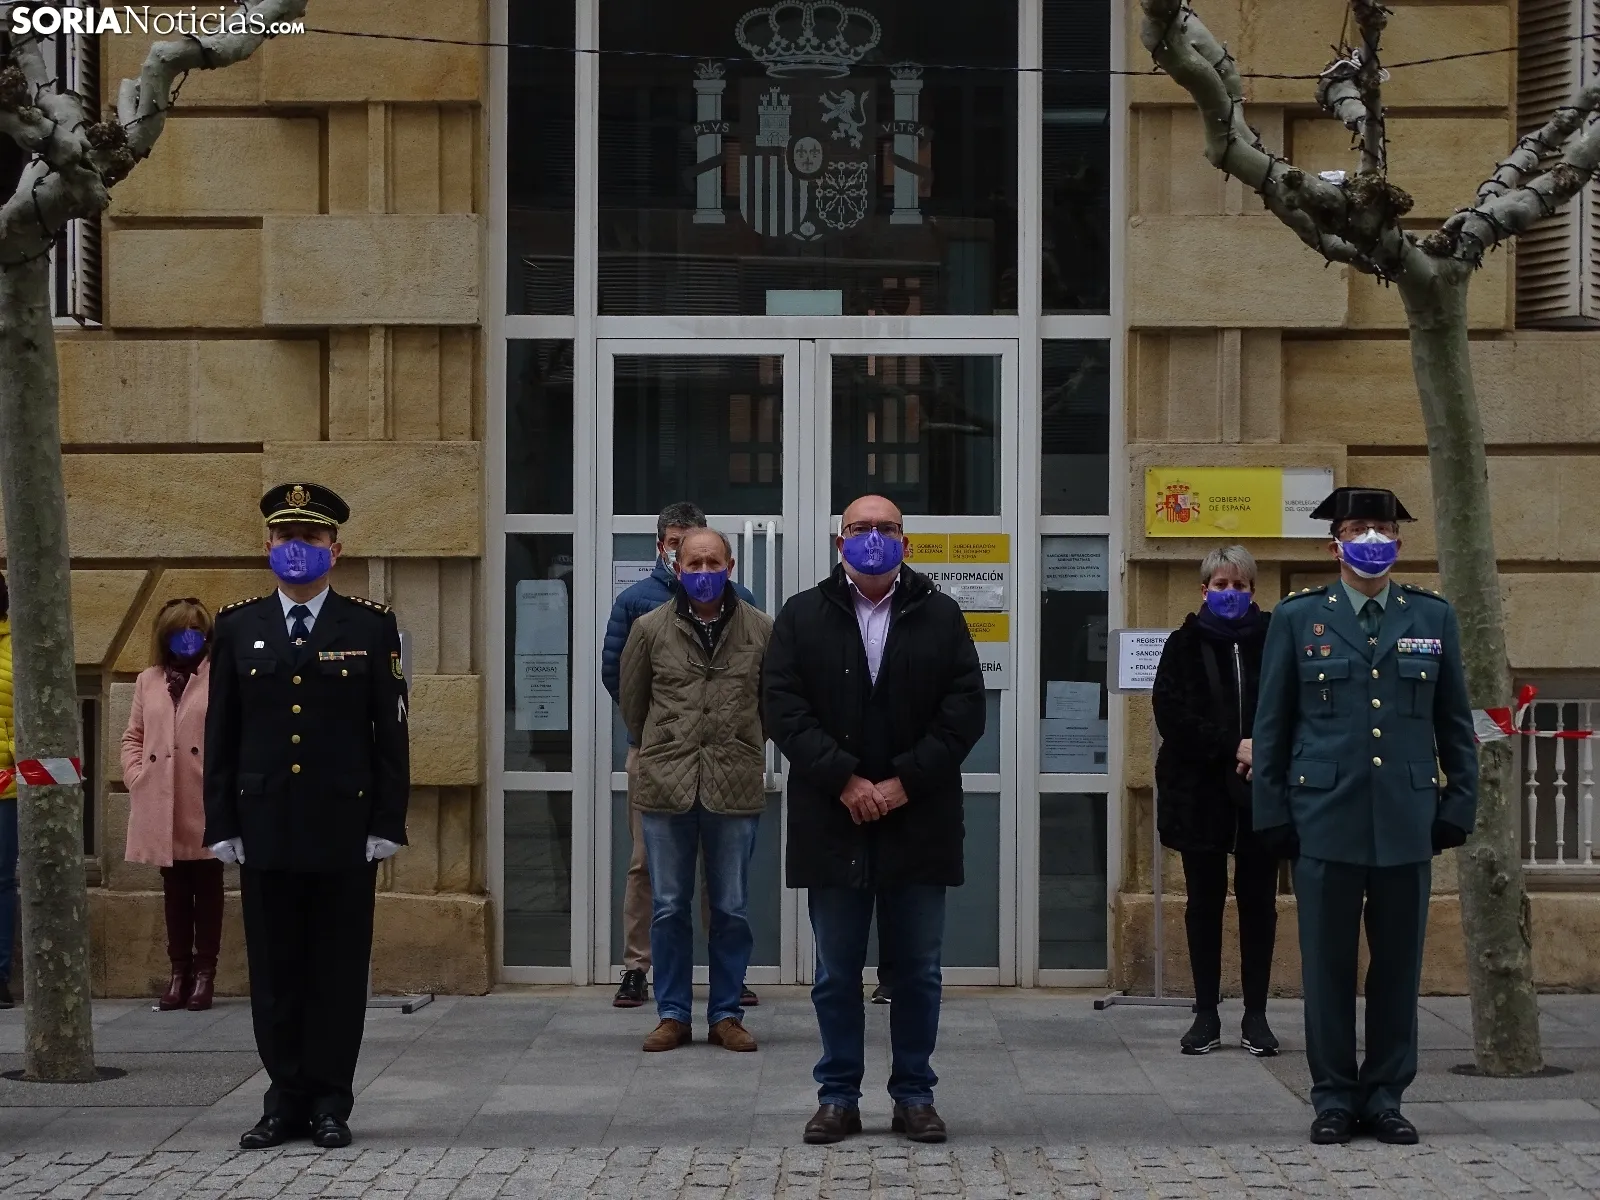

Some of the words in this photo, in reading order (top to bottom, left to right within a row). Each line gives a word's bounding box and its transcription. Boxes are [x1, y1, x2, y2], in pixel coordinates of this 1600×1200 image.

[1222, 503, 1252, 511] ESPAÑA
[927, 572, 939, 581] DE
[941, 569, 1004, 581] INFORMACIÓN
